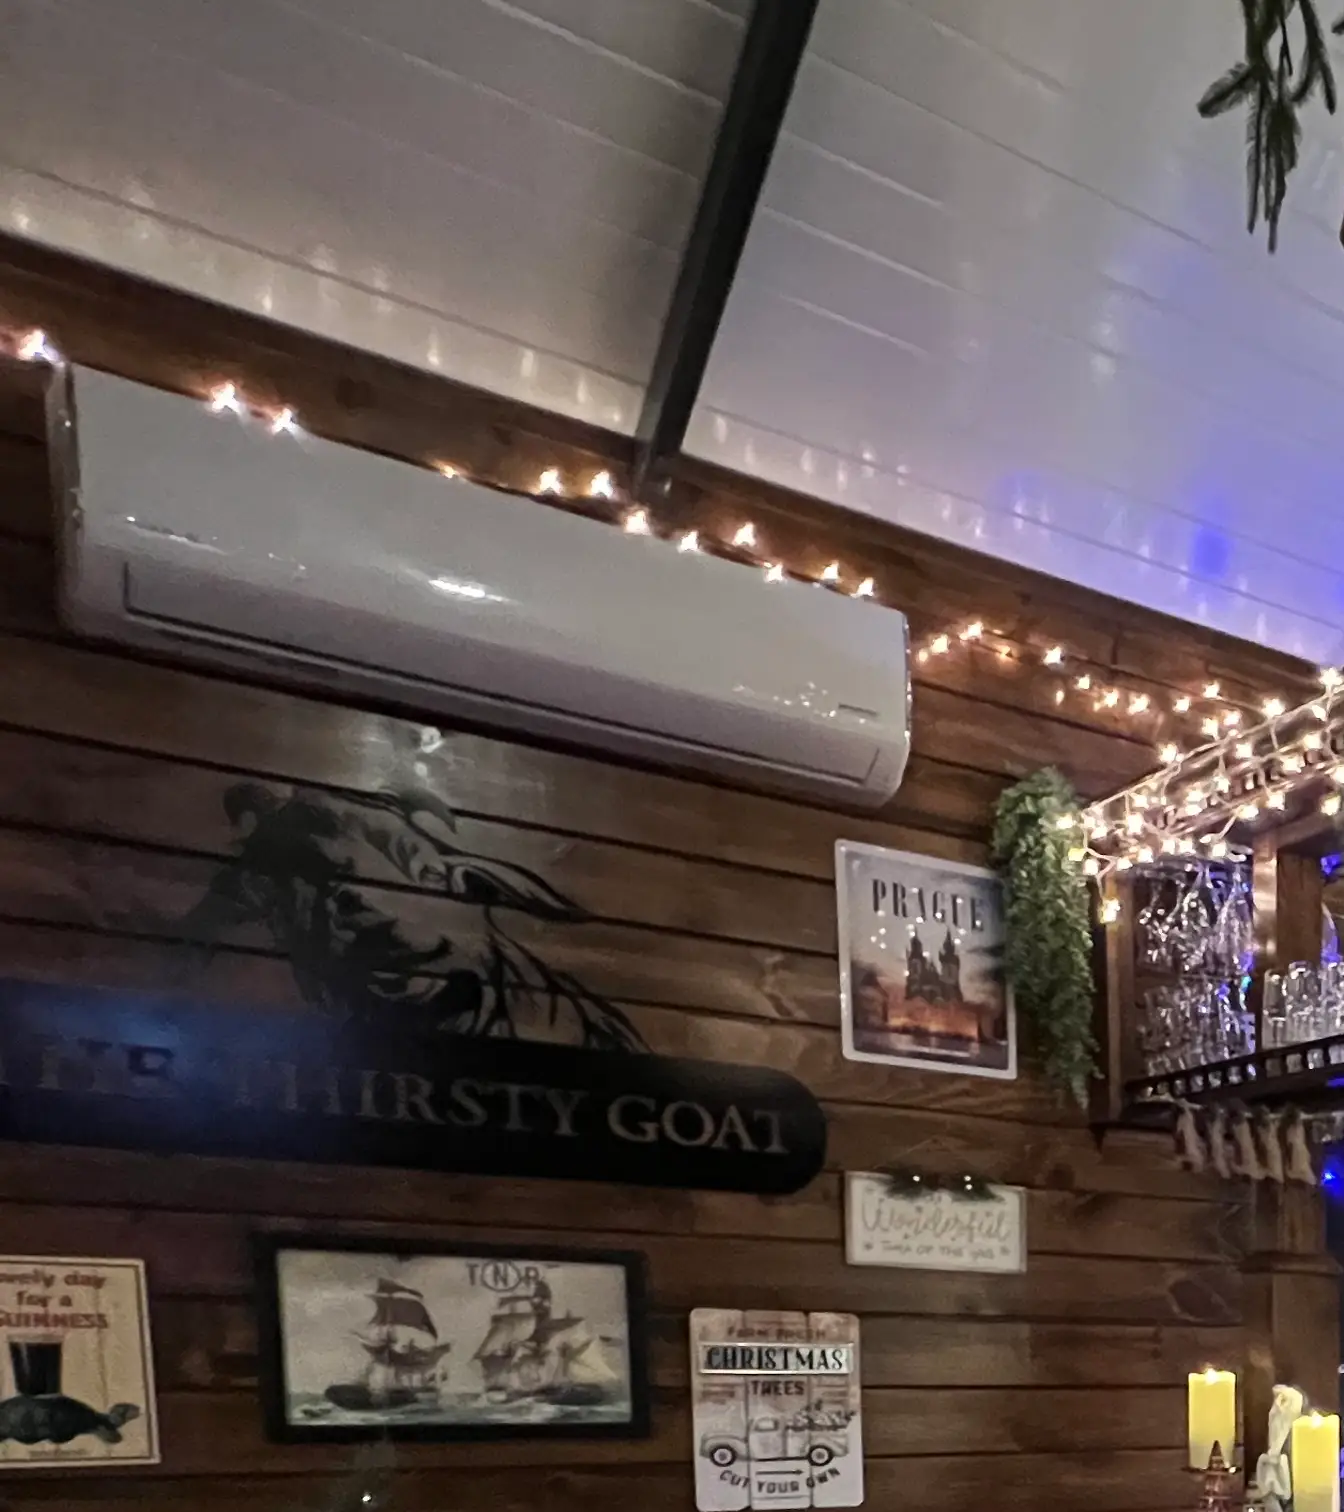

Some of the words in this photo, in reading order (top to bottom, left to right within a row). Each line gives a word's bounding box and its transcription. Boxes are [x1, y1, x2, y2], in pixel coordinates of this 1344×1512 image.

[872, 878, 984, 932] PRAGUE
[606, 1094, 790, 1155] GOAT
[64, 1271, 106, 1289] day
[17, 1290, 51, 1308] for
[60, 1294, 73, 1307] a
[705, 1345, 843, 1371] CHRISTMAS
[752, 1380, 805, 1396] TREES
[719, 1469, 750, 1489] CUT
[757, 1480, 801, 1494] YOUR
[806, 1466, 841, 1489] OWN
